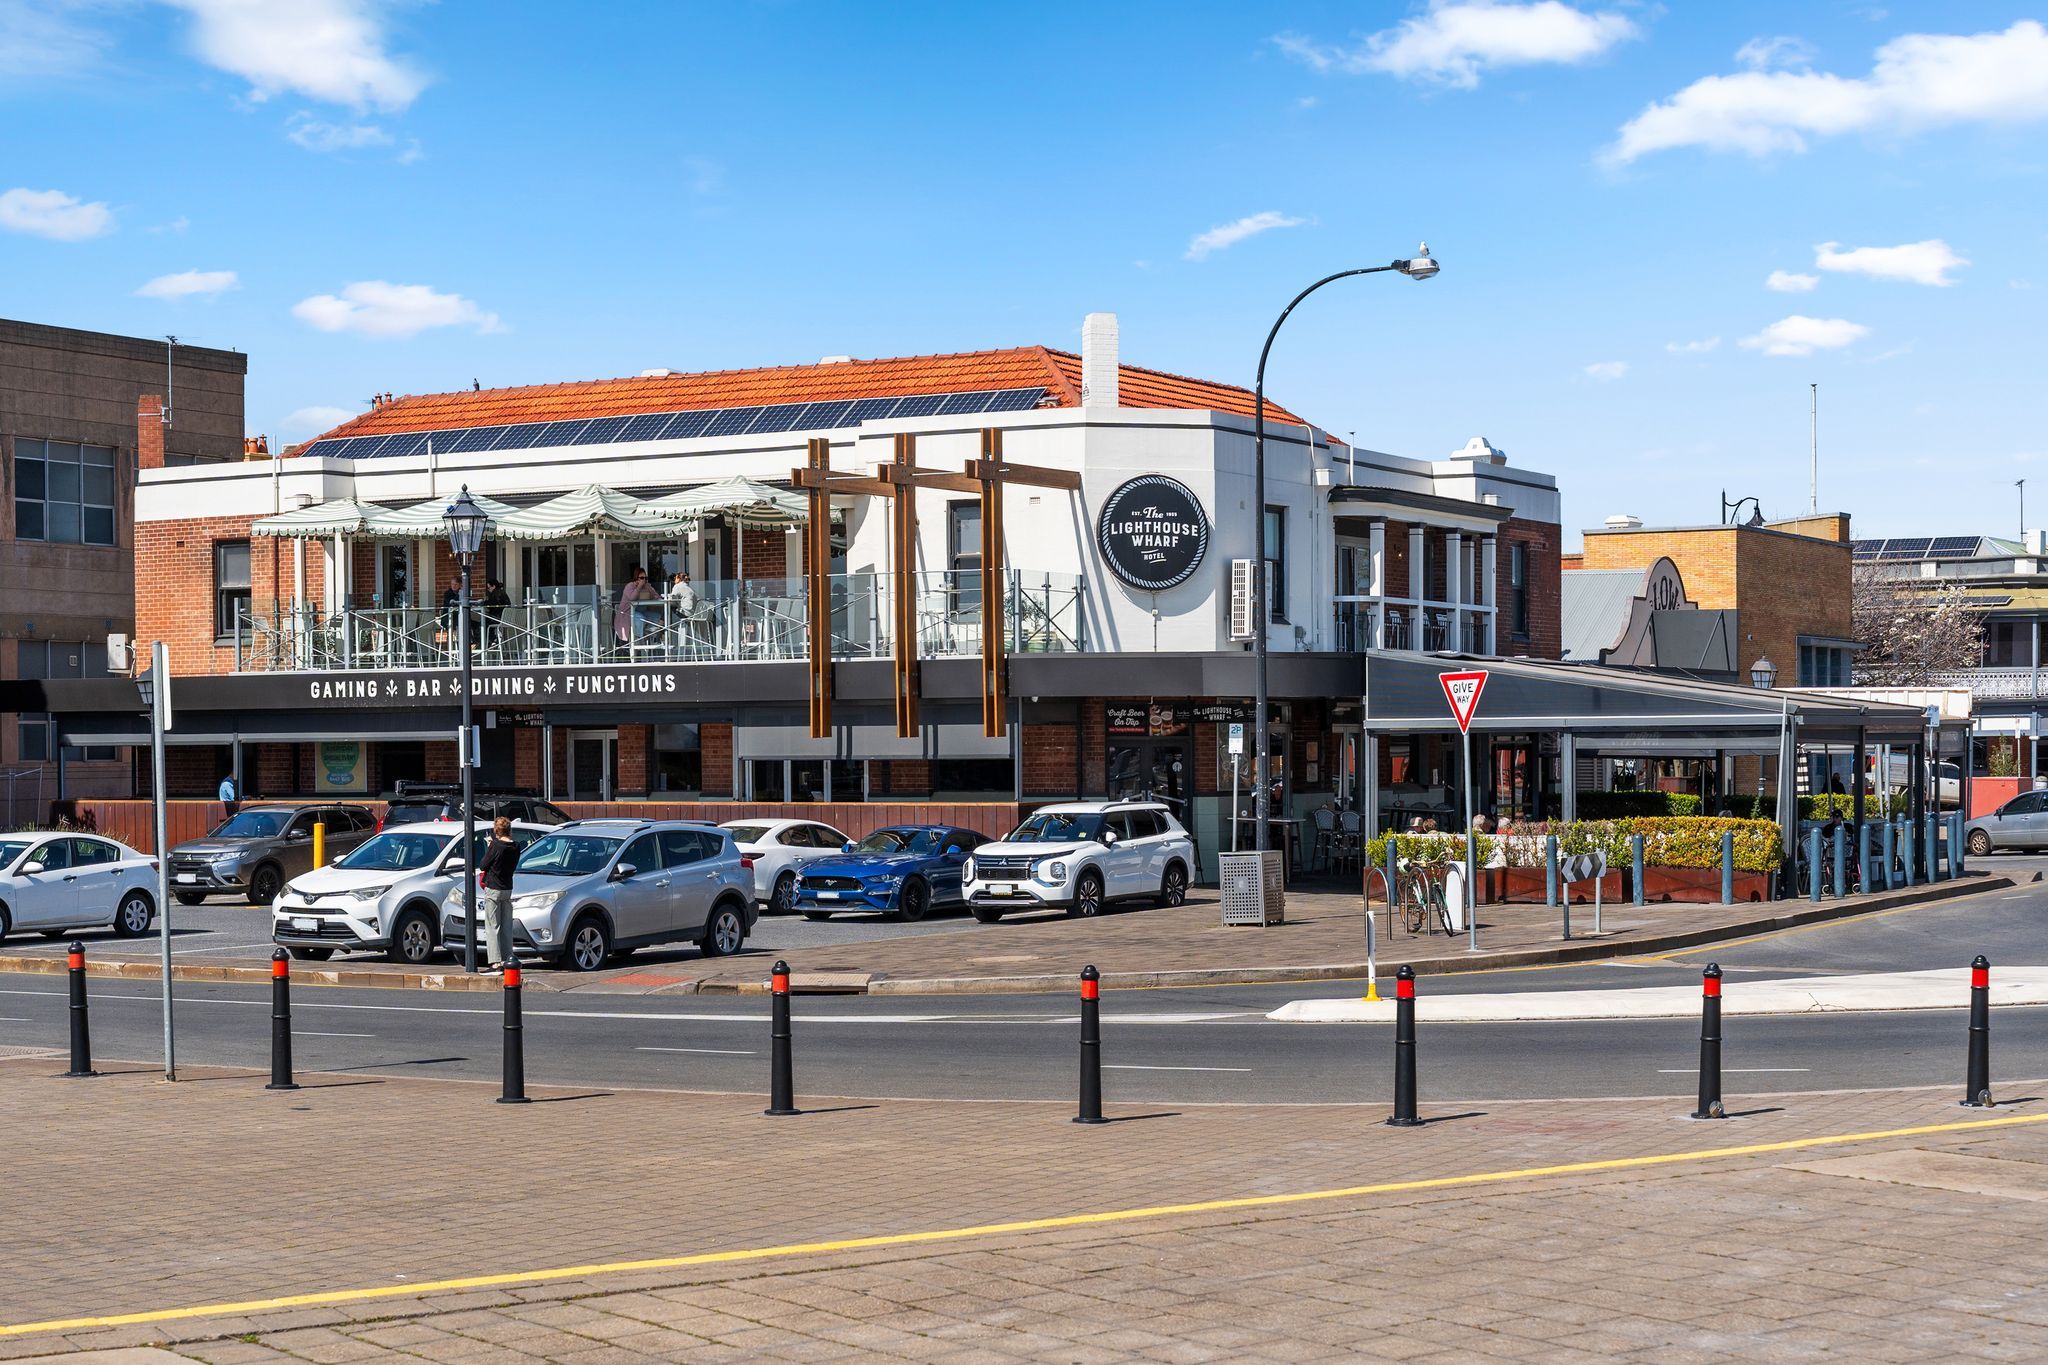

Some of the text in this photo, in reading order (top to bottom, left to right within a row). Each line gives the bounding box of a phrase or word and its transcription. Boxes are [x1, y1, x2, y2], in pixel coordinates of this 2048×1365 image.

[1143, 506, 1164, 519] The
[1111, 521, 1199, 537] LIGHTHOUSE
[1131, 535, 1179, 548] WHARF
[1143, 552, 1165, 560] HOTEL
[310, 674, 676, 698] GAMING BAR DINING FUNCTIONS
[1453, 682, 1474, 693] GIVE
[1457, 695, 1470, 703] WAY
[1107, 709, 1126, 718] Craft
[1202, 706, 1232, 715] LIGHTHOUSE
[1114, 718, 1140, 726] On Tap
[1231, 726, 1241, 734] 2P
